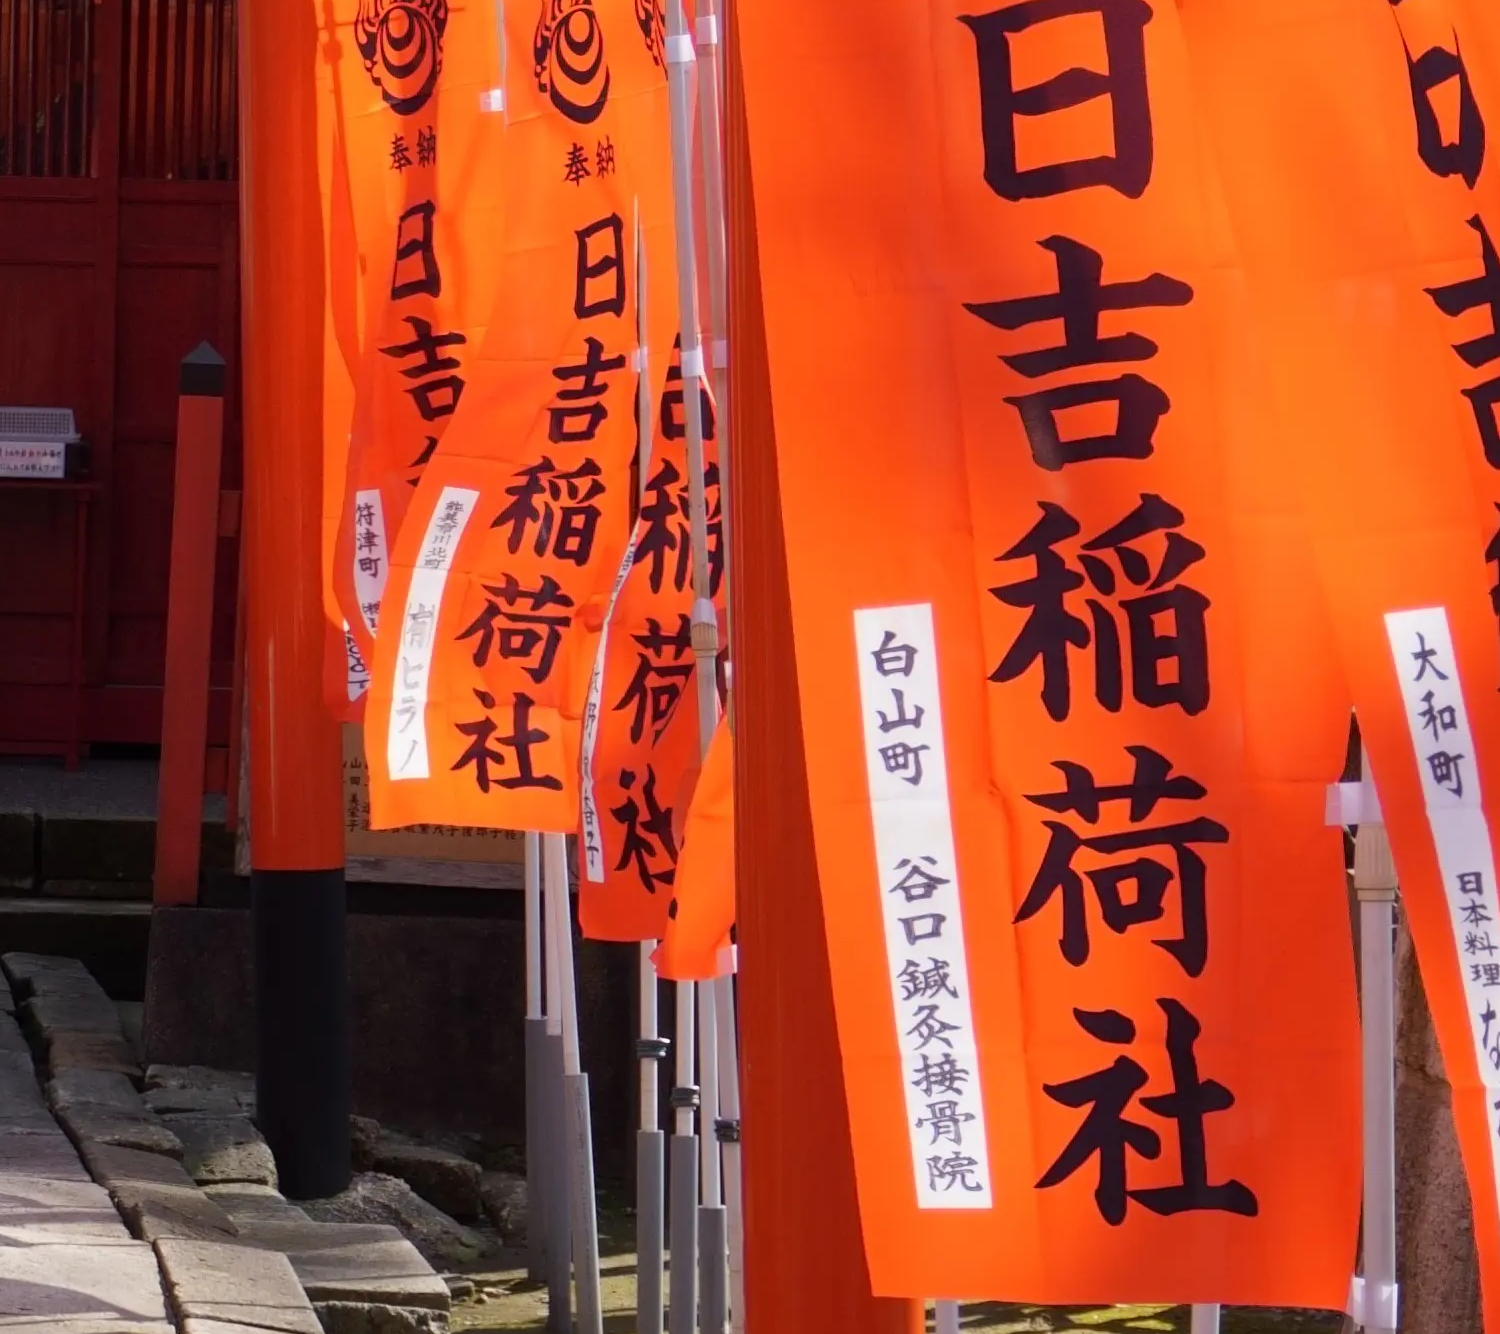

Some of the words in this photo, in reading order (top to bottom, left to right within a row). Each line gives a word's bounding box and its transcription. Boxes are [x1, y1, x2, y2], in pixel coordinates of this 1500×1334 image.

[389, 125, 437, 171] 奉納
[563, 134, 616, 188] 奉納
[378, 198, 468, 488] 日吉
[449, 210, 628, 795] 日吉稲荷社
[871, 630, 931, 786] 白山町
[1411, 631, 1466, 799] 大和町
[889, 854, 984, 1193] 谷口鍼灸接骨院
